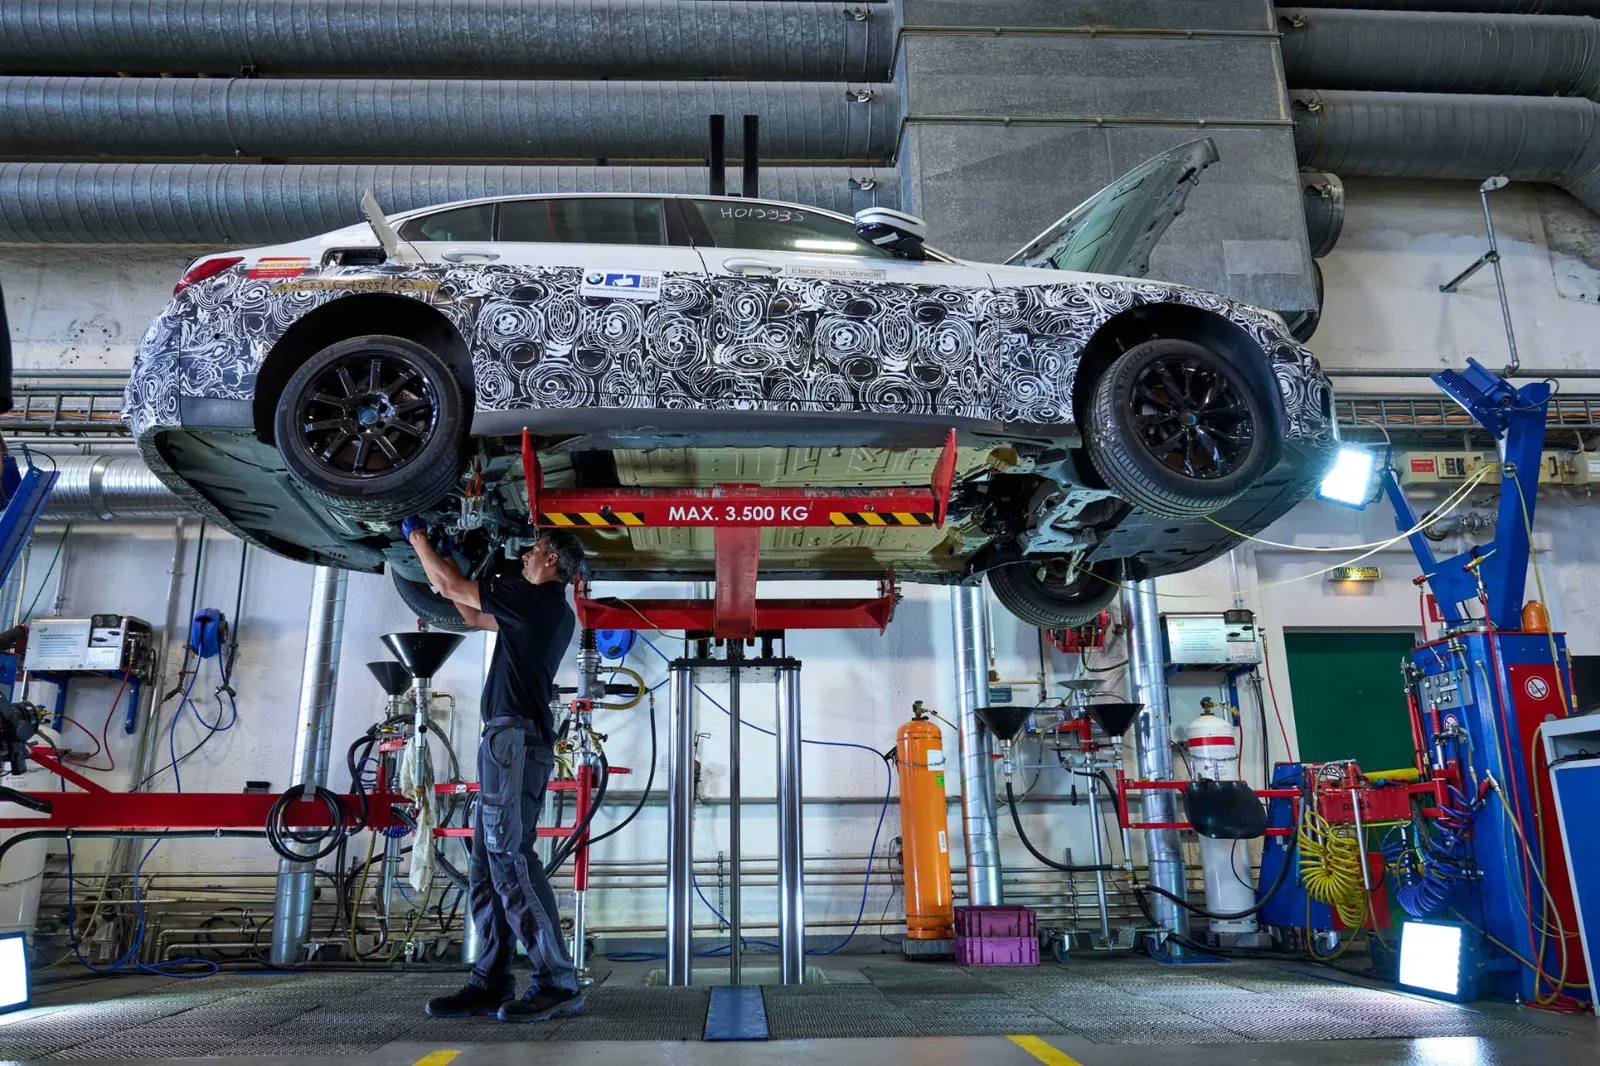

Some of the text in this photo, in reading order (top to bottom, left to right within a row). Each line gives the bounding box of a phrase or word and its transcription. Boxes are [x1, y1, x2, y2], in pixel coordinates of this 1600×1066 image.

[791, 267, 825, 275] Electric
[849, 270, 881, 278] Vehicle
[668, 506, 808, 521] MAX. 3.500 KG
